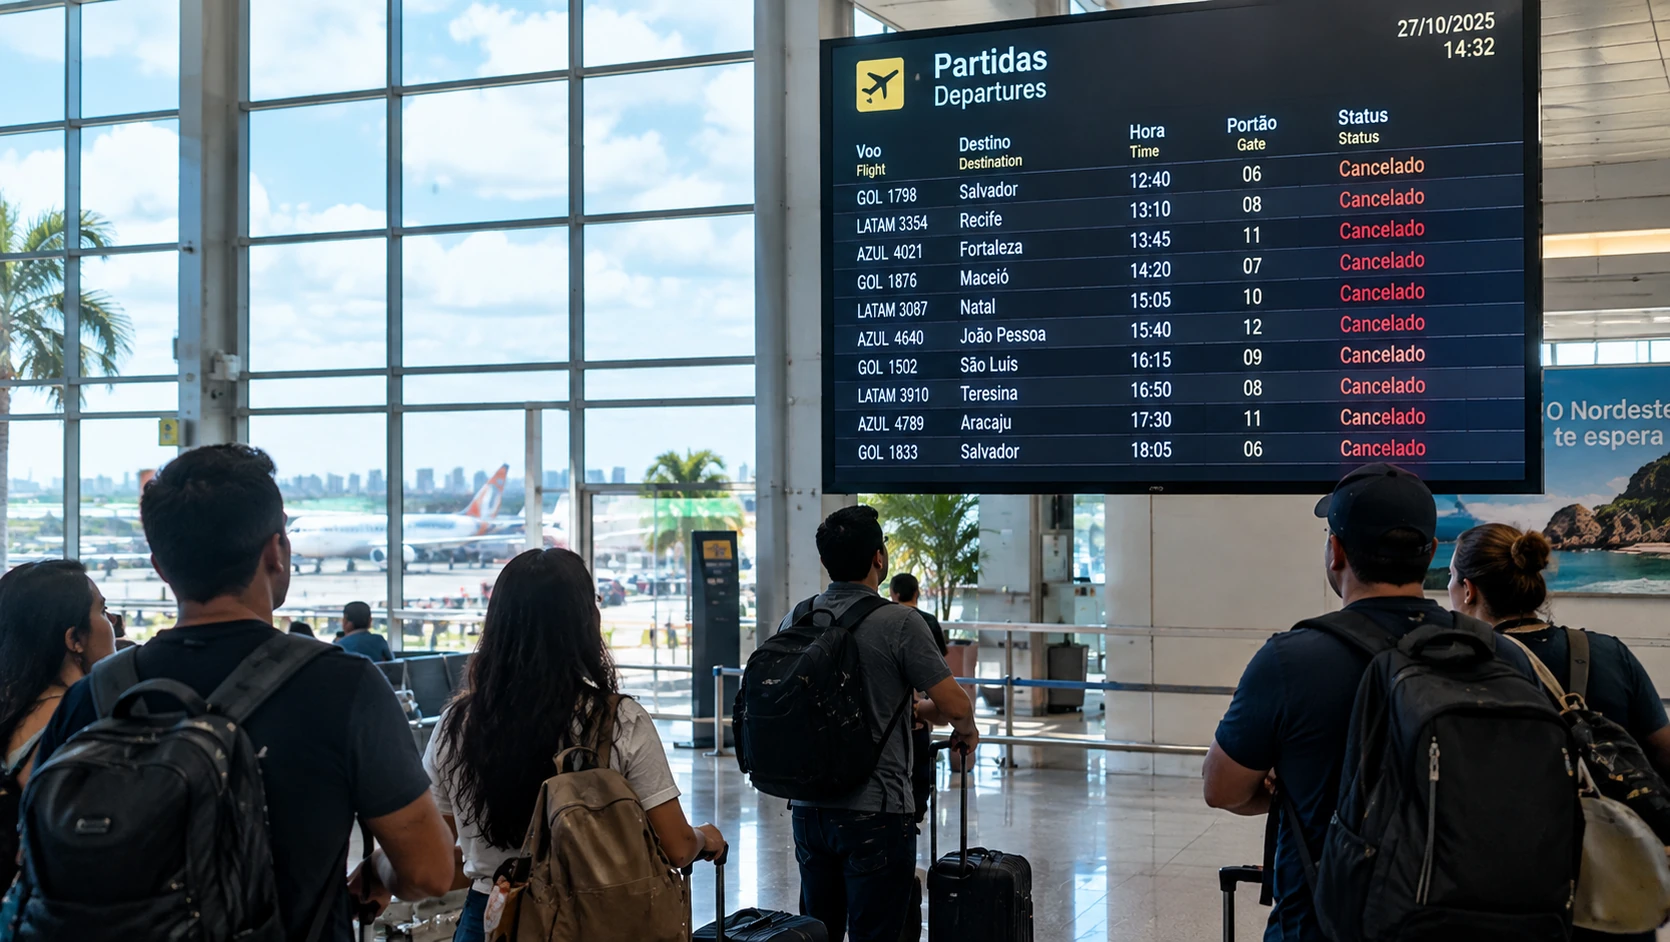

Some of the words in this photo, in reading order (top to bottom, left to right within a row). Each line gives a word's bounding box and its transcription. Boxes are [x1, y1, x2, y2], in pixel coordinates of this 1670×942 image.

[1397, 12, 1496, 37] 27/10/2025
[935, 46, 1047, 79] Partidas
[1444, 37, 1495, 58] 14:32
[935, 82, 1046, 110] Departures
[856, 144, 881, 159] Voo
[960, 135, 1011, 152] Destino
[1130, 124, 1165, 139] Hora
[1227, 115, 1277, 133] Portão
[1338, 109, 1388, 125] Status
[857, 163, 886, 178] Flight
[959, 155, 1022, 170] Destination
[1130, 145, 1159, 158] Time
[1237, 138, 1266, 151] Gate
[1339, 132, 1379, 145] Status
[857, 190, 883, 205] GOL
[888, 187, 917, 203] 1798
[960, 181, 1018, 199] Salvador
[1130, 171, 1170, 188] 12:40
[1243, 165, 1261, 182] 06
[1340, 156, 1424, 177] Cancelado
[857, 217, 895, 234] LATAM
[899, 215, 928, 231] 3354
[960, 210, 1002, 228] Recife
[1130, 200, 1171, 218] 13:10
[1243, 196, 1261, 212] 08
[1340, 188, 1424, 208] Cancelado
[857, 245, 889, 261] AZUL
[894, 244, 921, 259] 4021
[960, 239, 1023, 257] Fortaleza
[1131, 231, 1171, 248] 13:45
[1244, 227, 1259, 243] 11
[1340, 219, 1424, 239] Cancelado
[858, 274, 883, 290] GOL
[888, 272, 917, 288] 1876
[961, 268, 1009, 286] Maceió
[1131, 261, 1171, 278] 14:20
[1243, 257, 1262, 274] 07
[1340, 251, 1424, 270] Cancelado
[858, 302, 895, 318] LATAM
[899, 301, 928, 317] 3087
[961, 298, 995, 315] Natal
[1131, 291, 1171, 308] 15:05
[1244, 288, 1262, 304] 10
[1340, 282, 1424, 301] Cancelado
[857, 331, 889, 347] AZUL
[894, 330, 924, 345] 4640
[960, 327, 992, 344] João
[997, 327, 1046, 342] Pessoa
[1131, 321, 1171, 338] 15:40
[1244, 319, 1262, 335] 12
[1341, 314, 1425, 332] Cancelado
[858, 360, 883, 375] GOL
[889, 359, 917, 374] 1502
[1131, 351, 1171, 368] 16:15
[1244, 349, 1262, 365] 09
[1341, 345, 1425, 363] Cancelado
[858, 388, 896, 403] LATAM
[900, 387, 929, 402] 3910
[960, 385, 1018, 401] Teresina
[1131, 381, 1171, 398] 16:50
[1244, 379, 1262, 396] 08
[1341, 376, 1425, 394] Cancelado
[858, 416, 889, 431] AZUL
[895, 416, 924, 431] 4789
[961, 414, 1011, 433] Aracaju
[1131, 411, 1171, 428] 17:30
[1244, 410, 1260, 426] 11
[1341, 407, 1425, 425] Cancelado
[1546, 401, 1564, 421] O
[858, 445, 884, 460] GOL
[889, 444, 918, 460] 1833
[961, 443, 1020, 459] Salvador
[1132, 441, 1172, 458] 18:05
[1244, 441, 1262, 457] 06
[1341, 439, 1426, 456] Cancelado
[1553, 427, 1577, 447] te
[1584, 429, 1663, 450] espera
